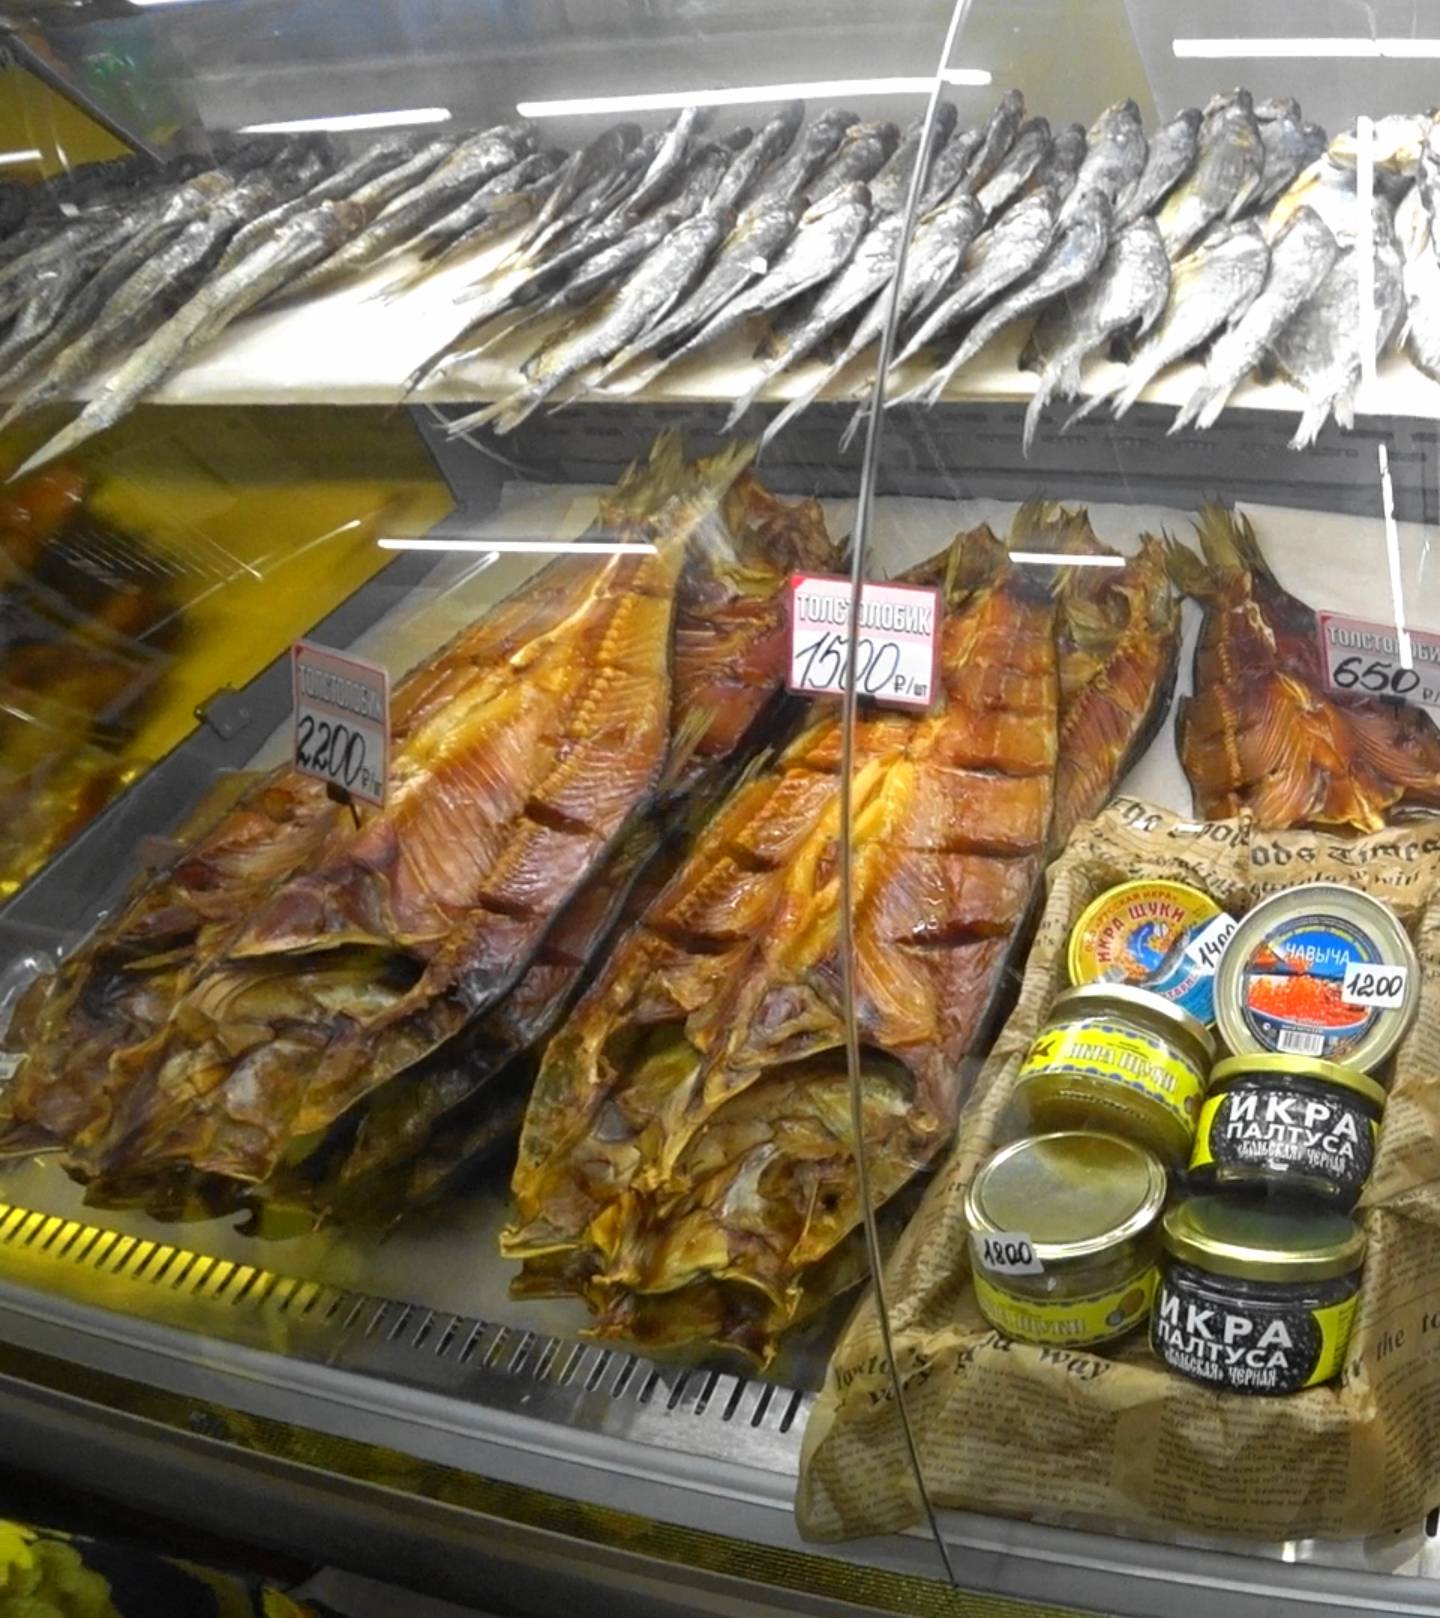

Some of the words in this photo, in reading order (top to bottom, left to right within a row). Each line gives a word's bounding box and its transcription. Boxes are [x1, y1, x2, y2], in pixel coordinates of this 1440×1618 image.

[795, 632, 900, 693] 1500
[1333, 656, 1420, 693] 650
[296, 715, 366, 786] 2200
[1127, 901, 1186, 923] ЩУКИ
[1285, 941, 1351, 966] ЧАВЫЧА
[1346, 972, 1402, 998] 1200
[1228, 1093, 1358, 1143] ИКРА
[1226, 1121, 1354, 1160] ПАЛТУСА
[983, 1238, 1033, 1266] 1800
[1160, 1288, 1294, 1349] ИКРА
[1158, 1319, 1289, 1369] ПАЛТУСА
[1376, 1328, 1406, 1362] the
